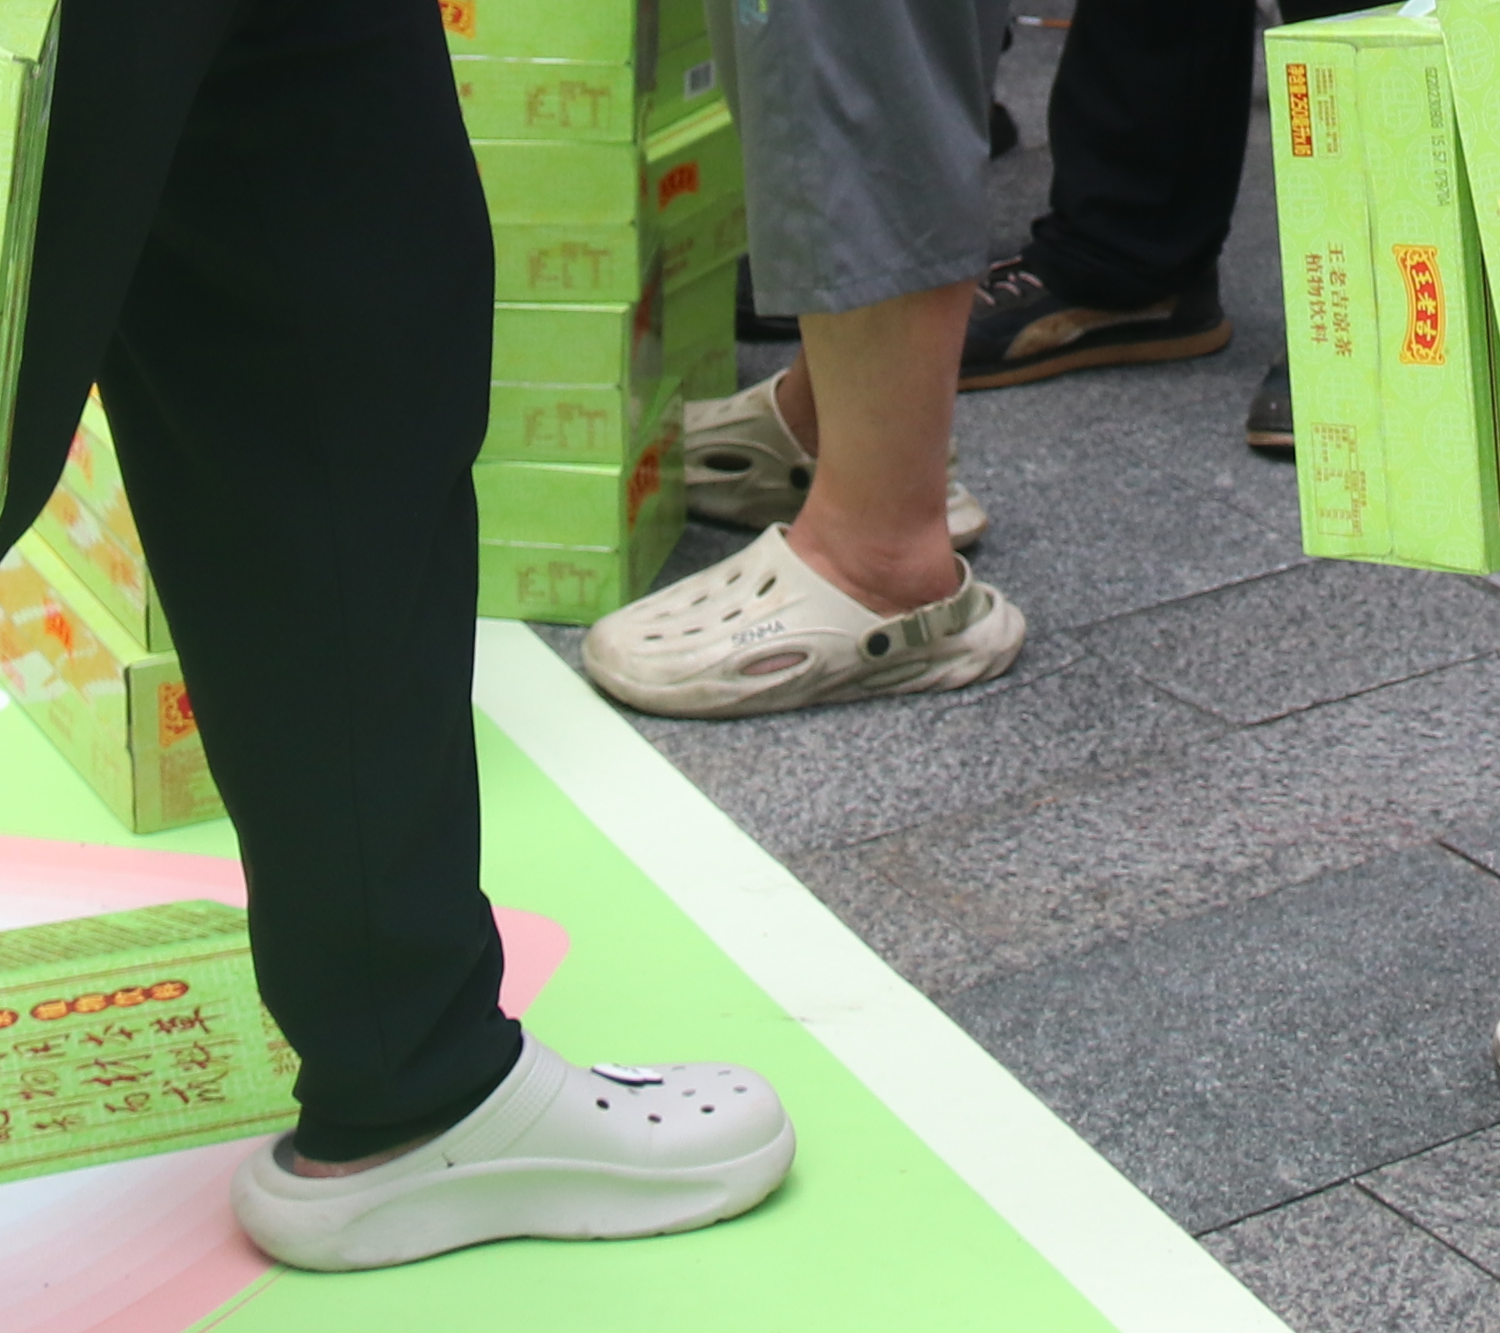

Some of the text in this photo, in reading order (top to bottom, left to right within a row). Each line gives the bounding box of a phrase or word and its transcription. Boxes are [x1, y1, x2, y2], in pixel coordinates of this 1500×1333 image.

[1304, 253, 1328, 346] 植物饮料
[1326, 241, 1353, 358] 王老吉凉茶
[1410, 263, 1438, 348] 王老吉
